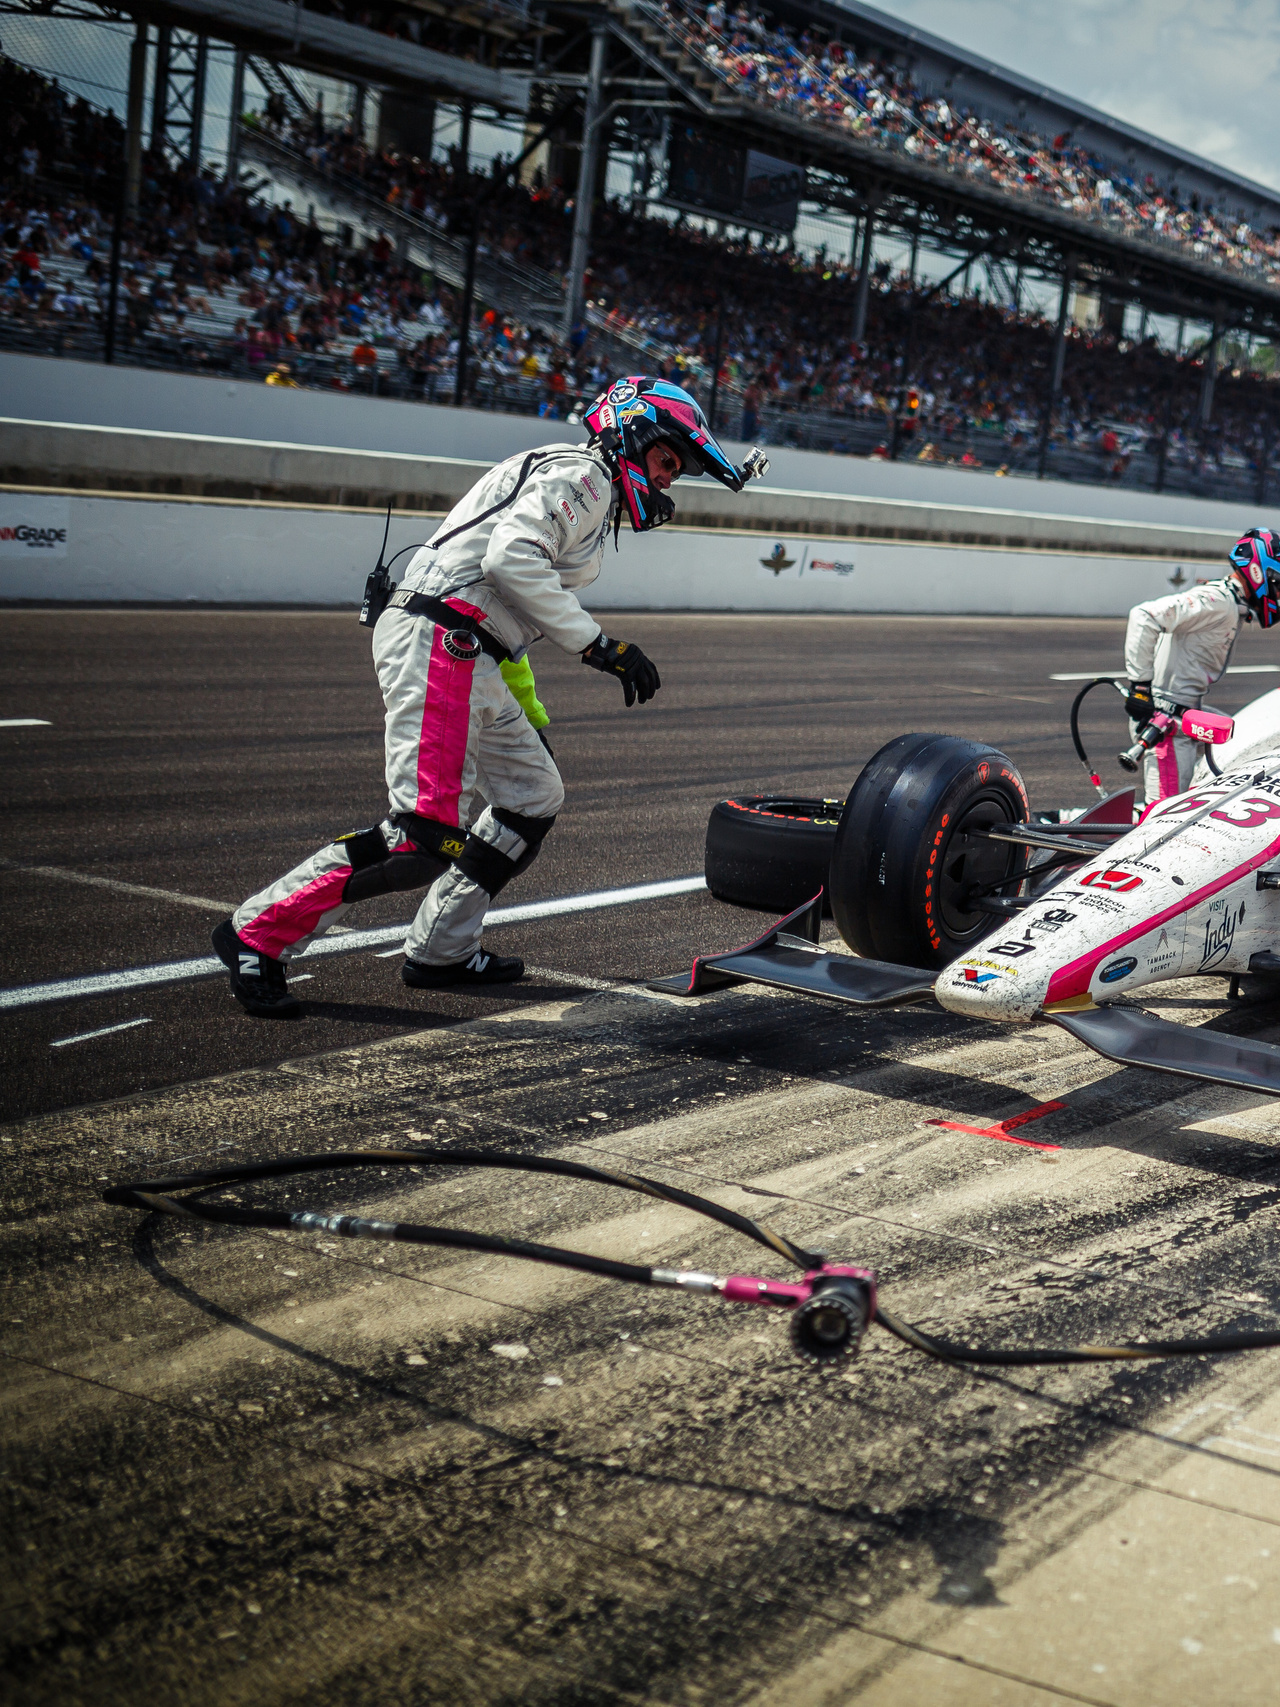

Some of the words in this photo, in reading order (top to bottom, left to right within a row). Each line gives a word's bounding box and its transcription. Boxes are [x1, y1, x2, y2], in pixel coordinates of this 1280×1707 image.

[603, 408, 613, 427] BELL
[561, 501, 575, 522] BELL
[1209, 900, 1225, 912] VISIT
[1197, 905, 1237, 972] Indy
[1147, 951, 1177, 966] TAMARACK
[1150, 962, 1171, 975] AGENCY
[952, 980, 988, 993] Valvoline
